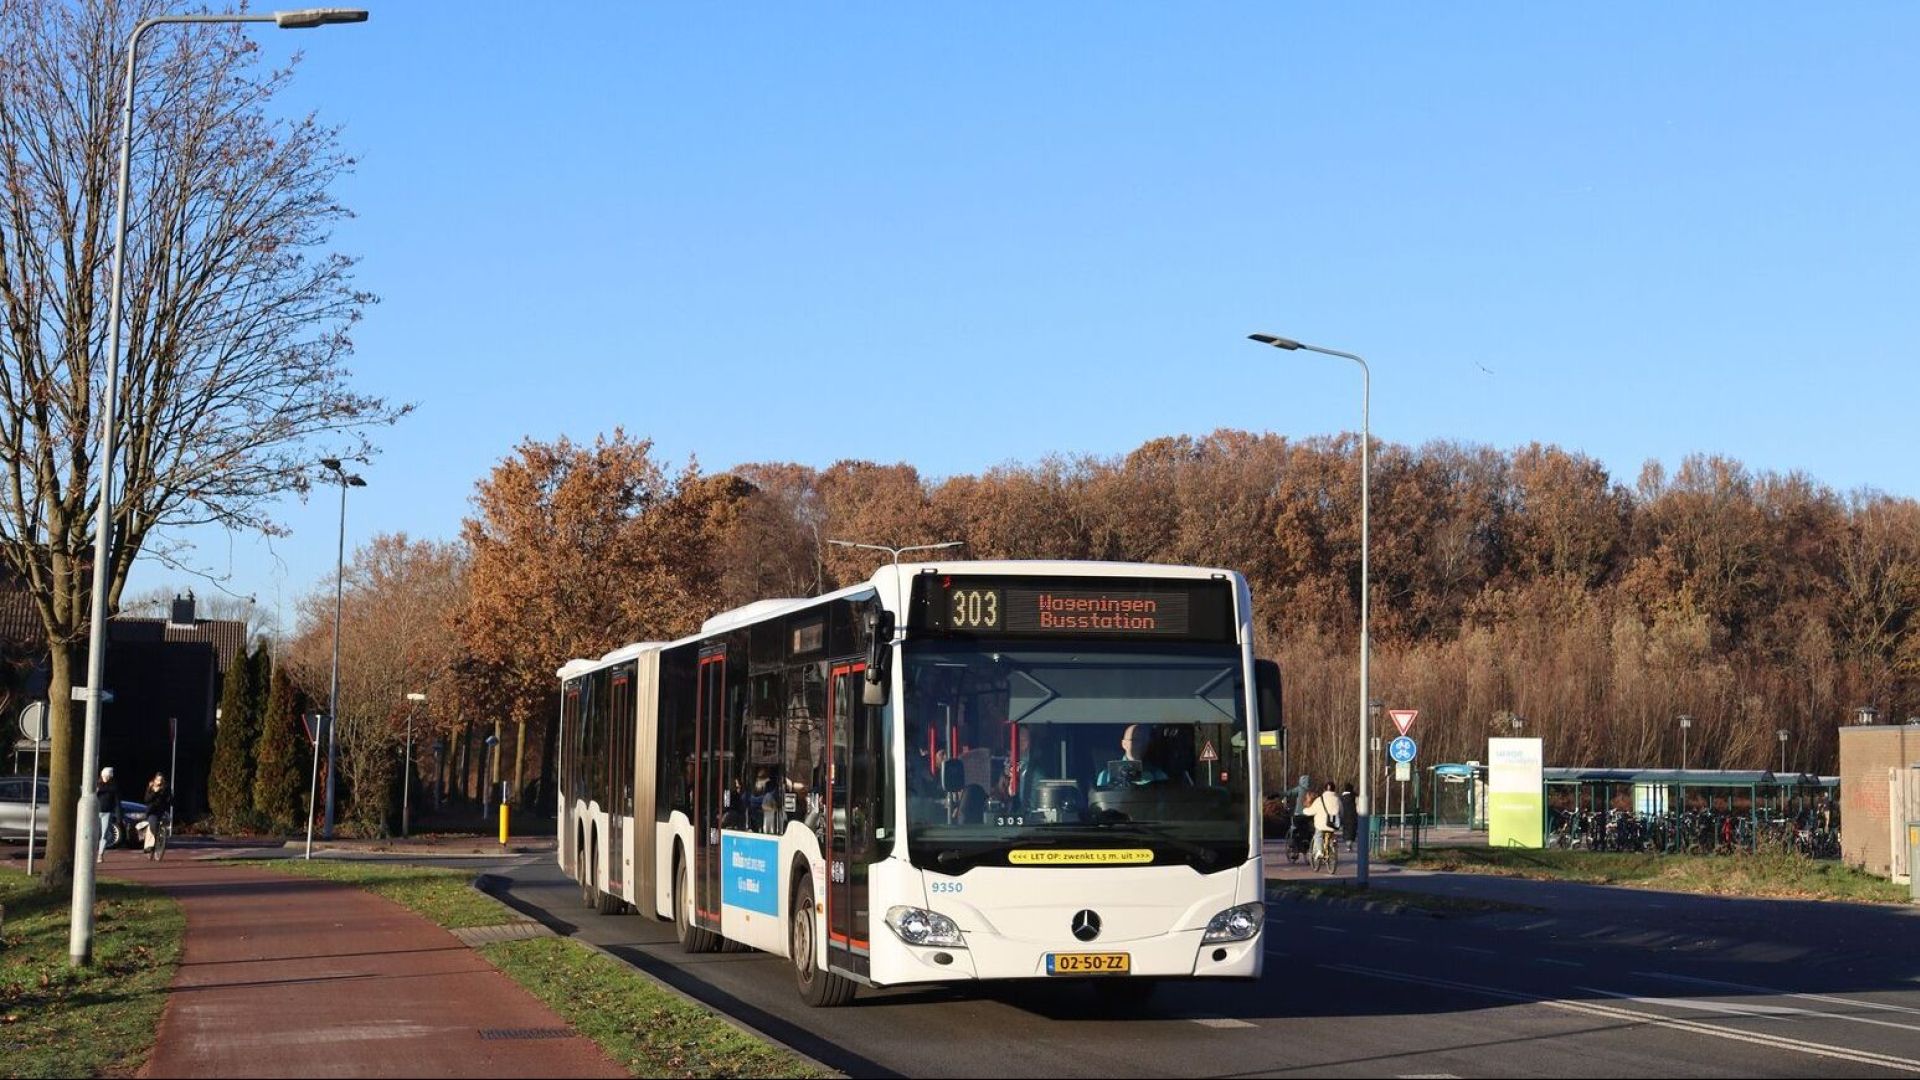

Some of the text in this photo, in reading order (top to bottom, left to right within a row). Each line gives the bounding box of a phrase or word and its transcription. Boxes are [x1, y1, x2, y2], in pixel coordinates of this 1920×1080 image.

[953, 590, 997, 627] 303
[1039, 593, 1156, 612] Wageningen
[1040, 611, 1155, 629] Busstation
[1064, 852, 1094, 861] zwenkt
[1121, 852, 1133, 860] uit
[931, 882, 963, 893] 9350
[1060, 956, 1123, 969] 02-50-ZZ
